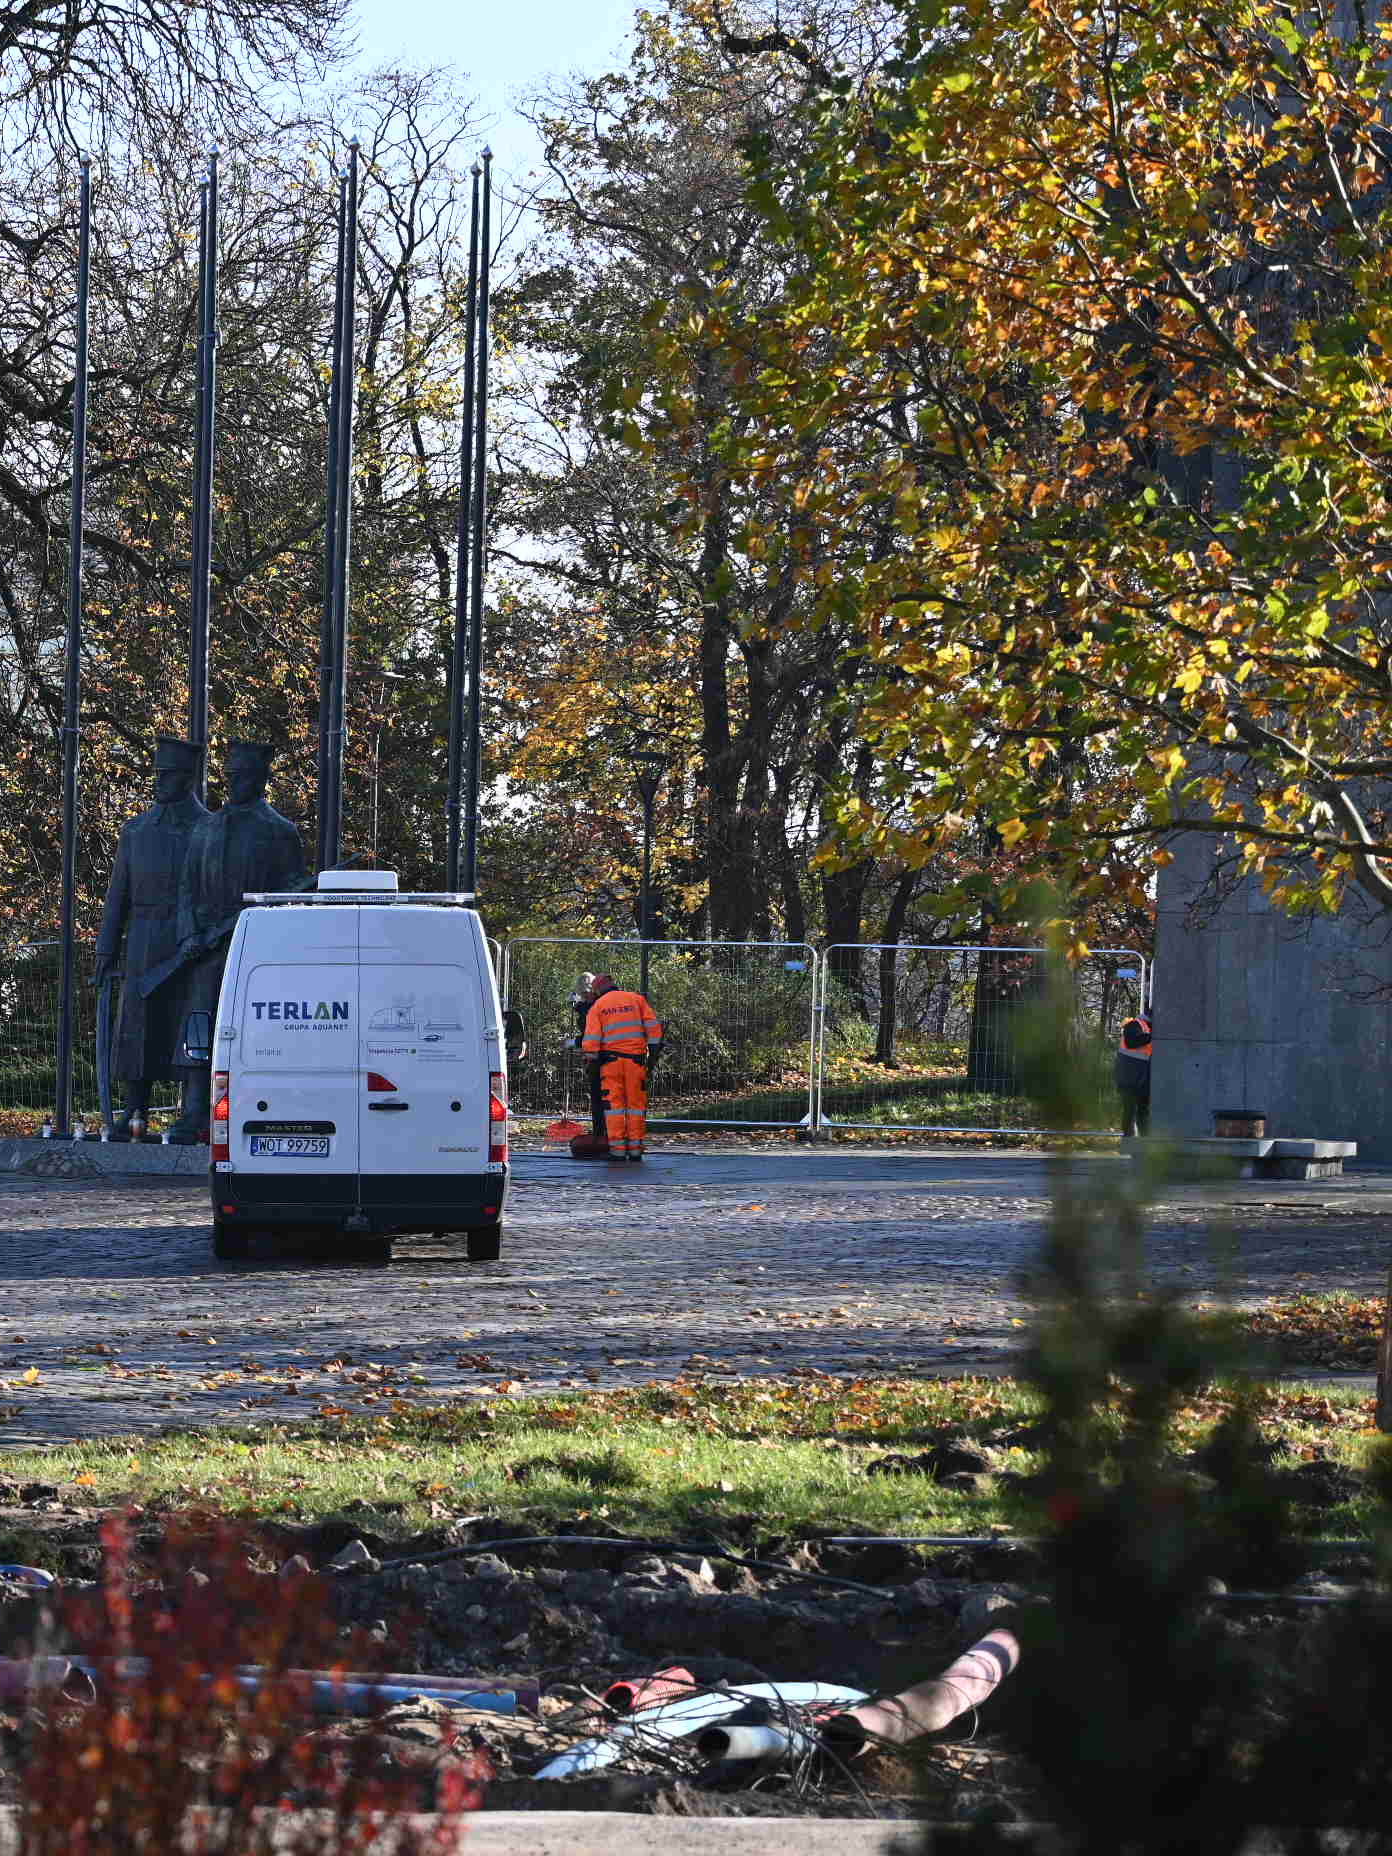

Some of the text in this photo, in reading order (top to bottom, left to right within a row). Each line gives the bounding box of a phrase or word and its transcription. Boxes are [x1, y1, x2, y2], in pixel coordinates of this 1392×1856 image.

[251, 1001, 349, 1020] TERLAN
[259, 1138, 327, 1152] WOT 99759
